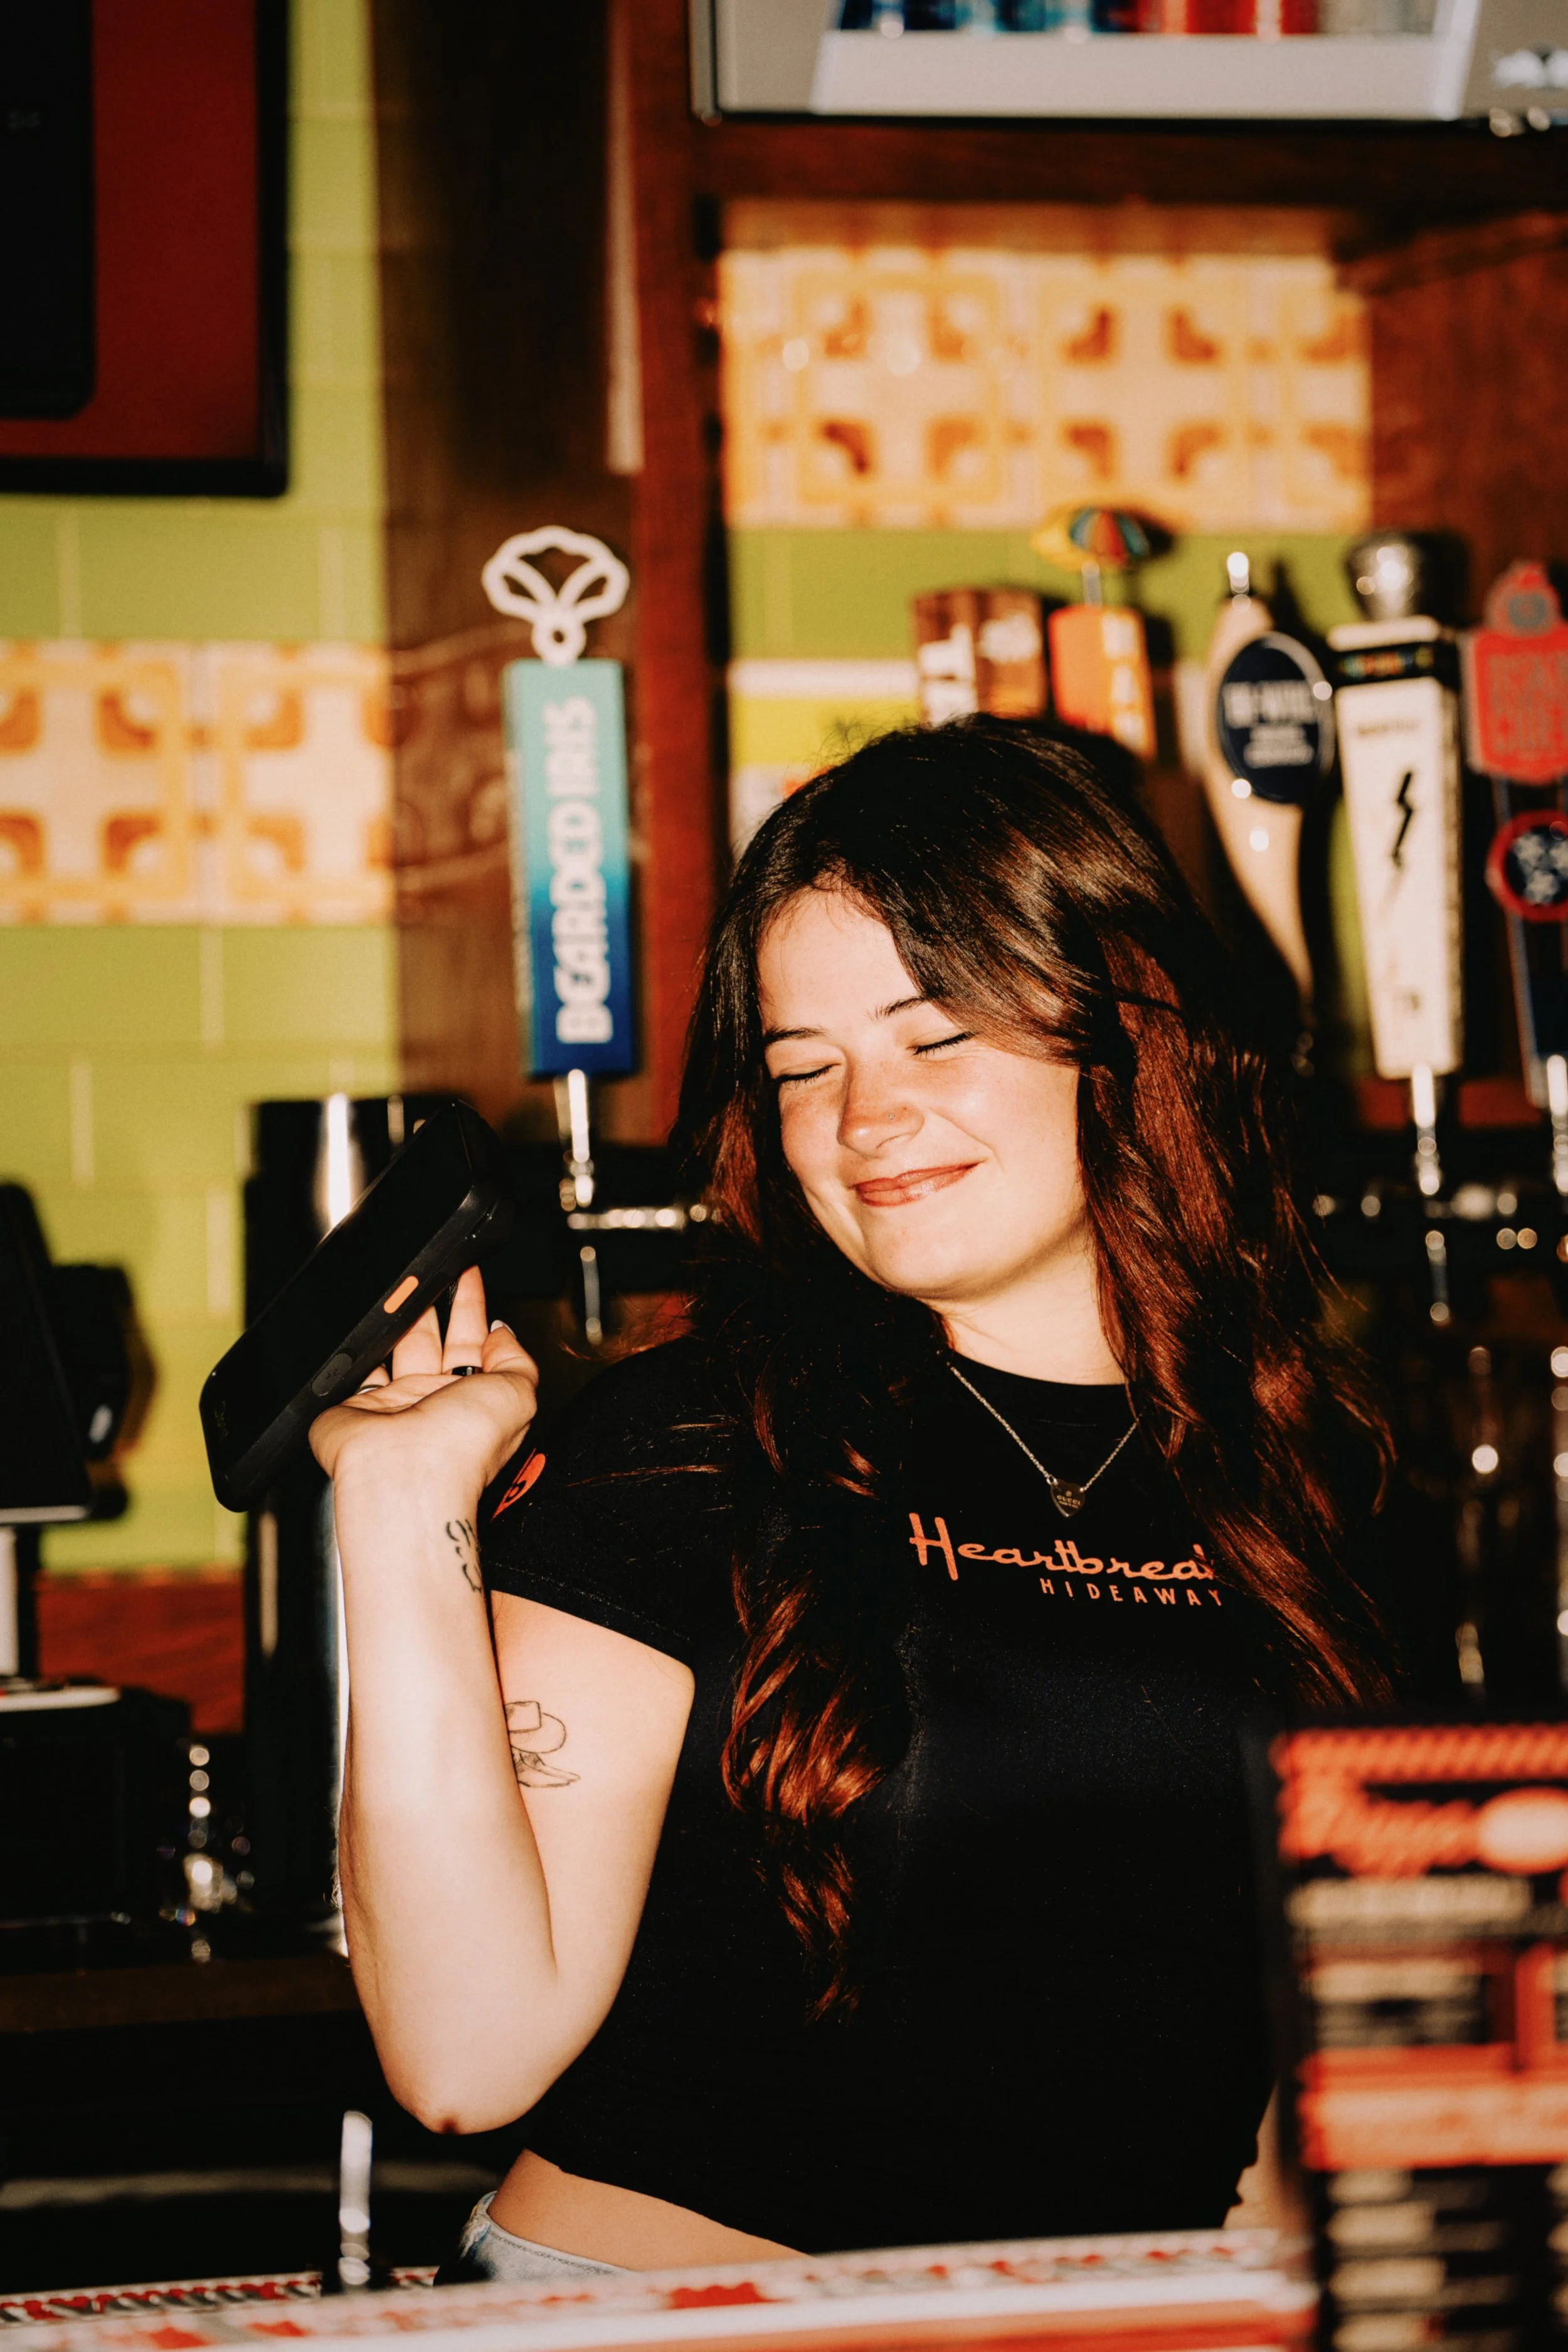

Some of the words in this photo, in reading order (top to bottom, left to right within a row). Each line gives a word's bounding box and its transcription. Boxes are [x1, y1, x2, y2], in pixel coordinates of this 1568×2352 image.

[544, 695, 603, 798] IRIS
[549, 799, 613, 1044] BEARDED
[1056, 1495, 1081, 1506] GUCCI
[1039, 1577, 1222, 1606] HIDEAWAY
